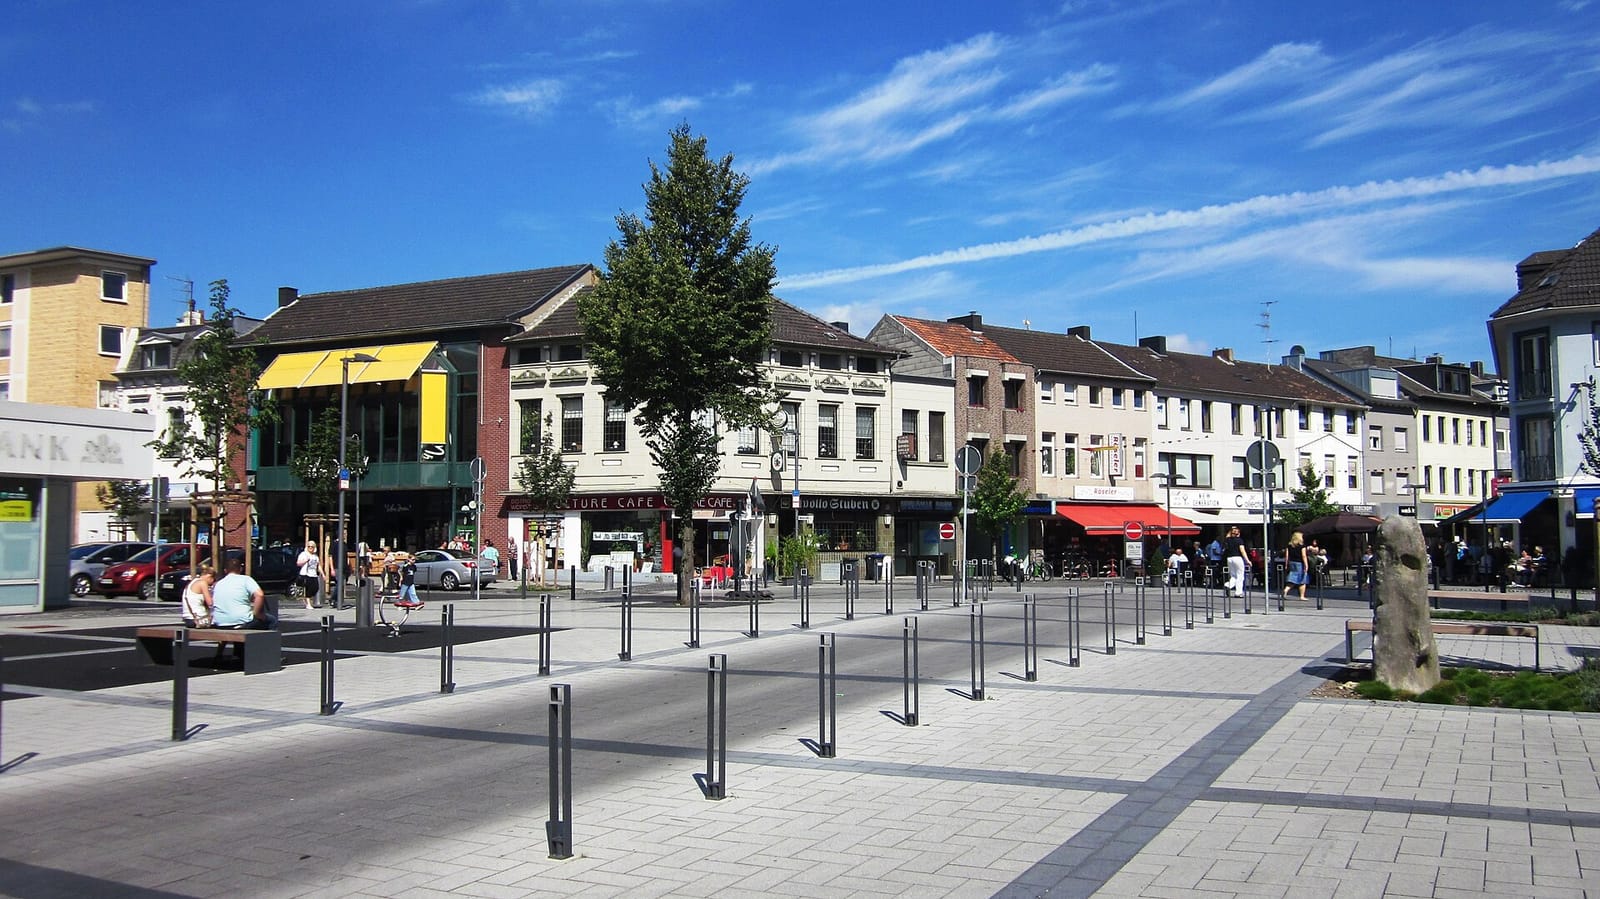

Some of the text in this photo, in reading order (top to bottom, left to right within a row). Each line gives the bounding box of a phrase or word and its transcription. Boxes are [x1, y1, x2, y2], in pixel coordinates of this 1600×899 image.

[617, 497, 654, 508] CAFE
[707, 497, 733, 508] CAFE
[829, 498, 869, 509] Stuben
